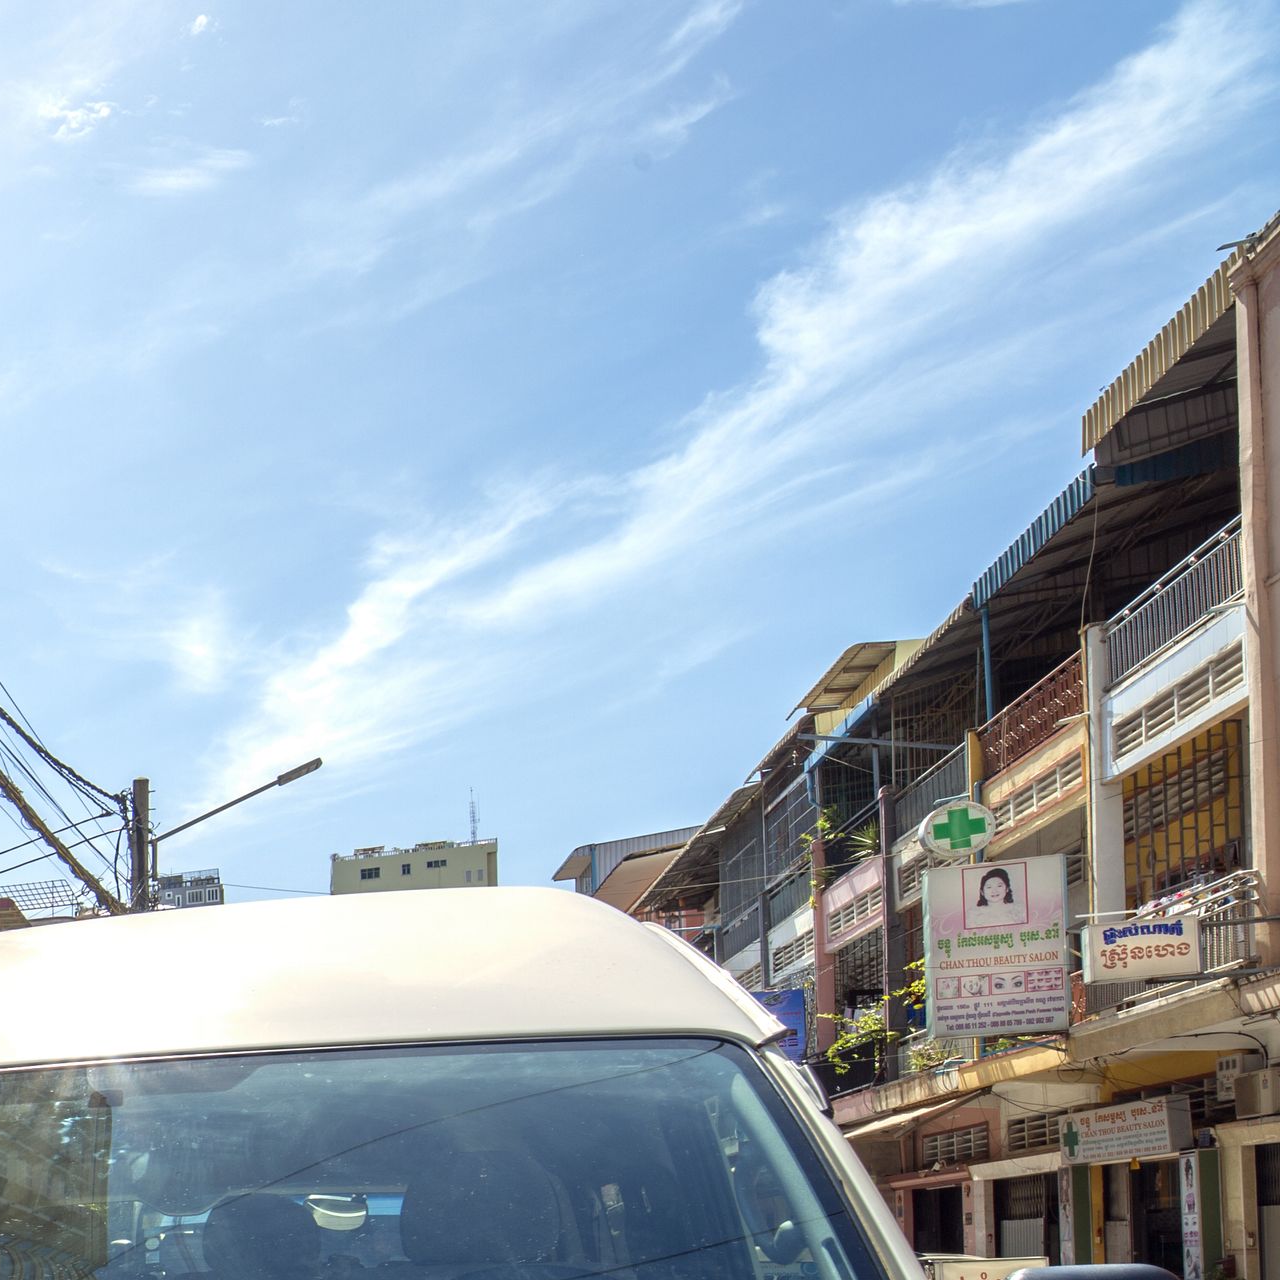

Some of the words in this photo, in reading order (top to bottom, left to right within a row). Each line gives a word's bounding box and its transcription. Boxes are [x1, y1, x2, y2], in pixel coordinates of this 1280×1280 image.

[940, 960, 965, 970] CHAN
[966, 957, 991, 968] THOU
[994, 954, 1028, 966] BEAUTY
[1029, 951, 1059, 963] SALON
[1117, 1122, 1142, 1134] BEAUTY
[1142, 1118, 1166, 1130] SALON
